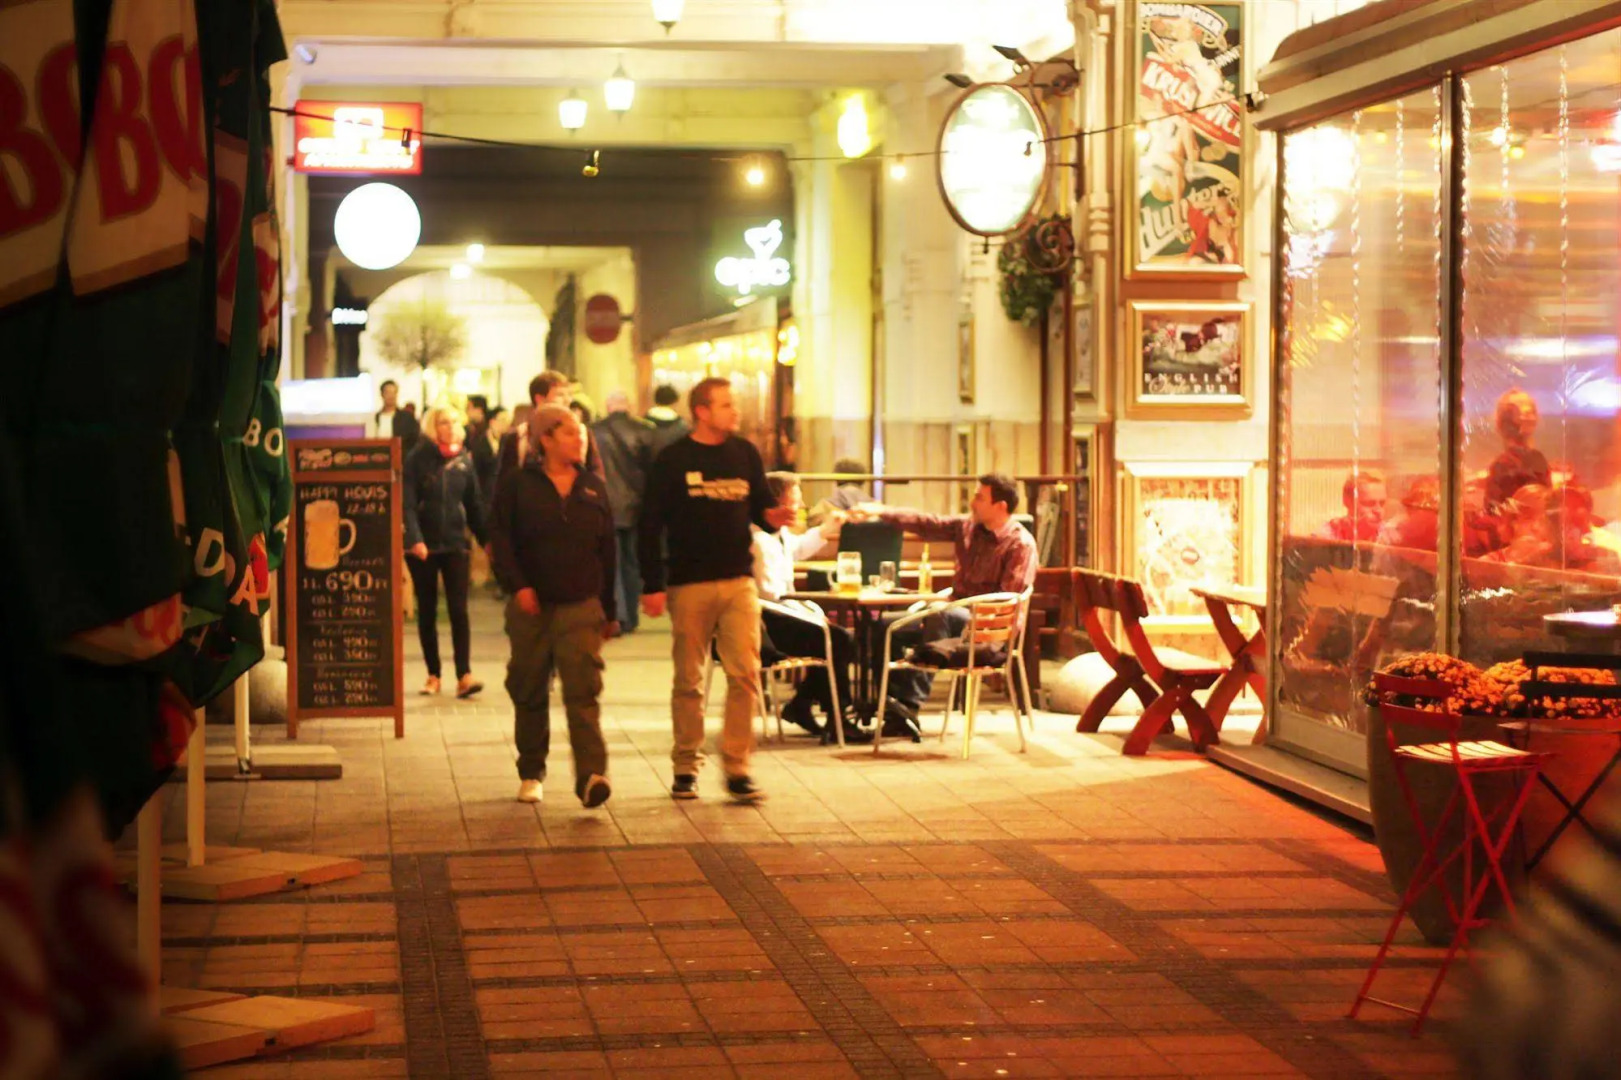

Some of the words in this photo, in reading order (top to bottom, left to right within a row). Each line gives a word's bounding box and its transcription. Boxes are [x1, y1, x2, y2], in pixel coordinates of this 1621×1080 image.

[1143, 372, 1238, 383] ENGLISH
[1193, 384, 1228, 394] PUB
[325, 570, 374, 591] 690
